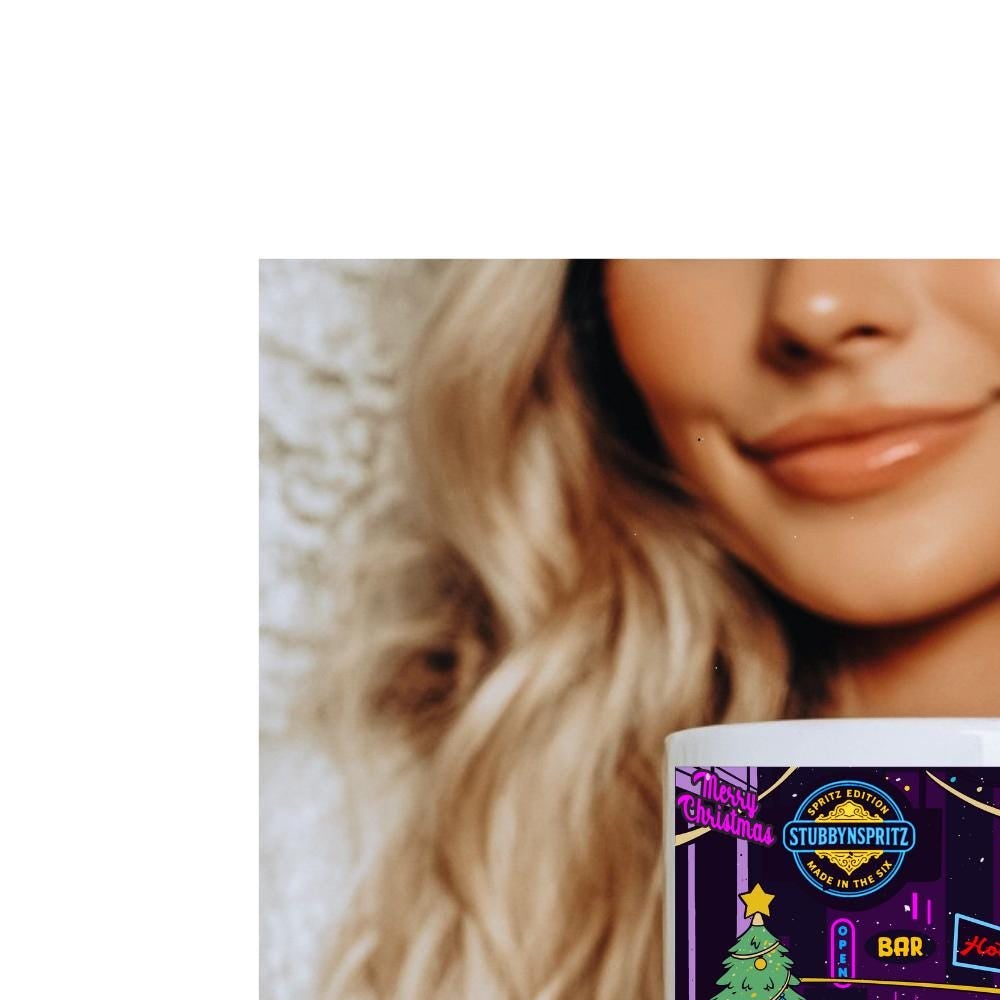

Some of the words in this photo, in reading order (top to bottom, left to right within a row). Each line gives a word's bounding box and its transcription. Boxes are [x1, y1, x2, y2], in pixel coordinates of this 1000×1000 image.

[691, 770, 758, 818] Merry
[807, 791, 842, 816] SPRITZ
[847, 789, 889, 815] EDITION
[678, 794, 775, 845] Christmas
[789, 827, 909, 846] STUBBYNSPRITZ
[806, 860, 833, 887] MADE
[836, 879, 849, 889] IN
[853, 872, 876, 888] THE
[875, 860, 893, 880] SIX
[838, 926, 848, 978] OPEN
[877, 937, 924, 957] BAR
